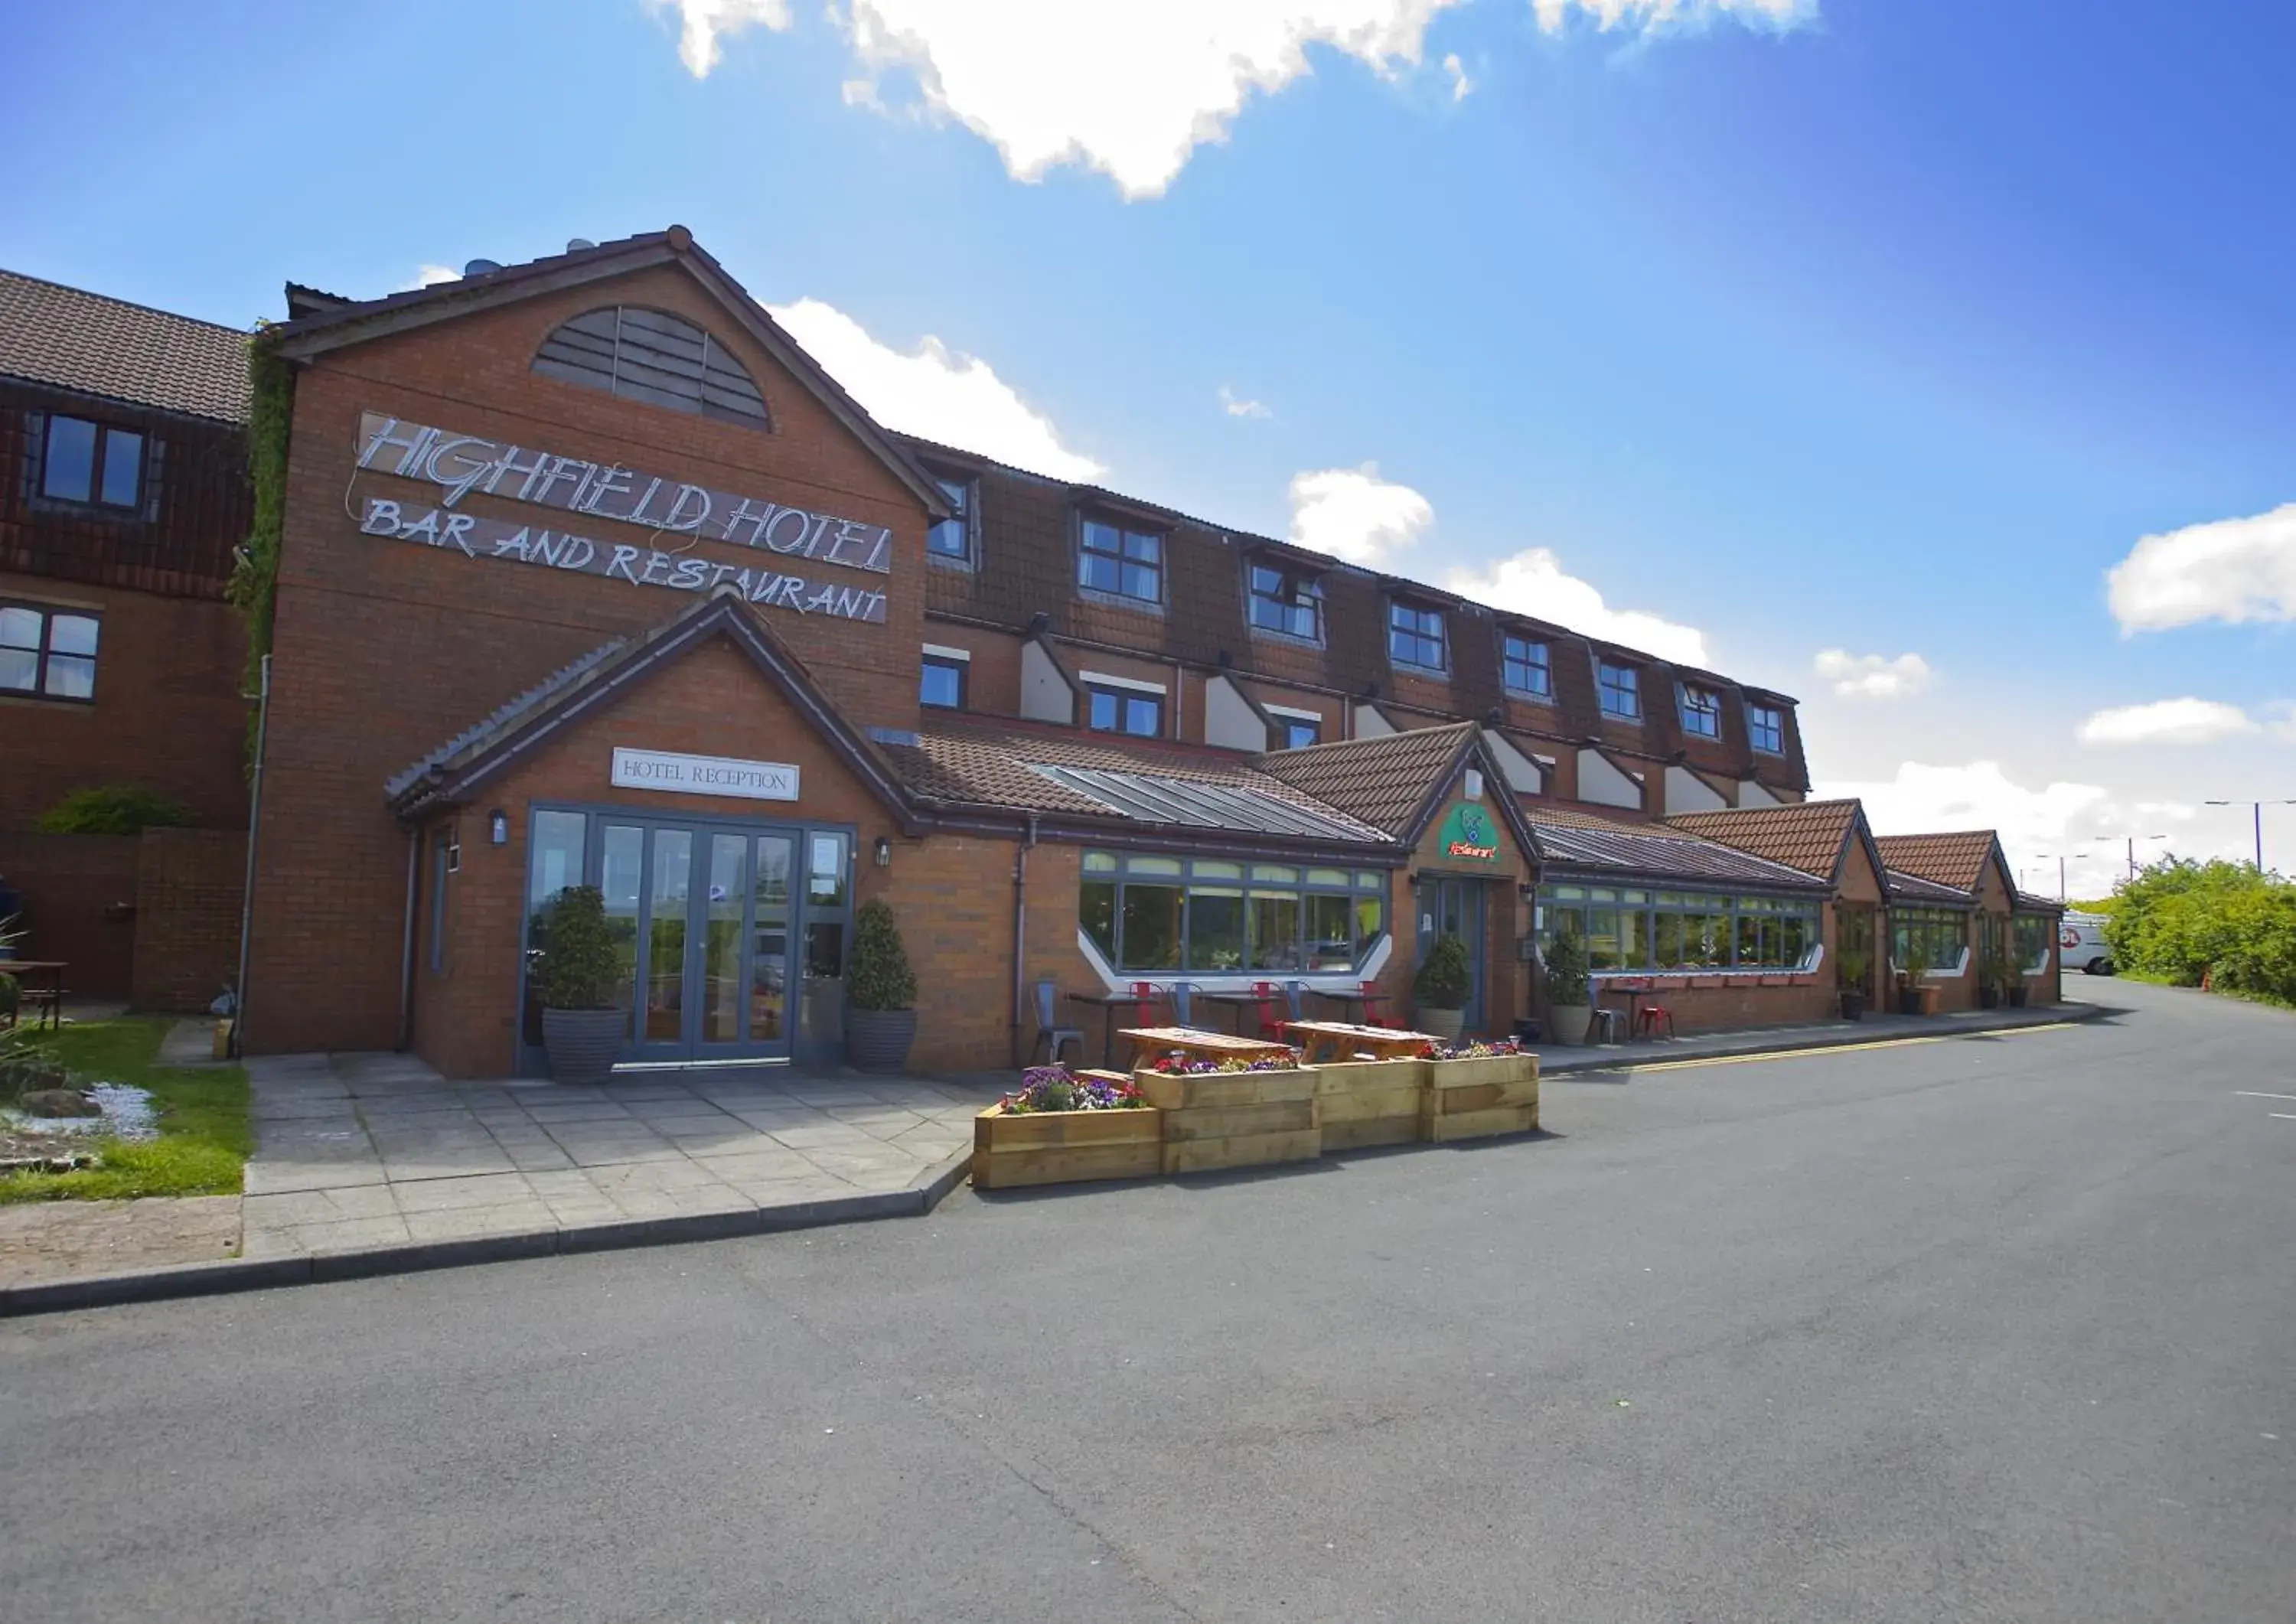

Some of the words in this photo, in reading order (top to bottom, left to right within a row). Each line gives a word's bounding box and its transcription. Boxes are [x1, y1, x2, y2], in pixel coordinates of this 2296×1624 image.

[357, 418, 712, 530] HIGHFIELD
[722, 497, 892, 574] HOTEL
[360, 499, 476, 559] BAR
[491, 527, 595, 569] AND
[605, 544, 887, 621] RESTAURANT
[623, 760, 684, 781] HOTEL
[692, 765, 788, 790] RECEPTION
